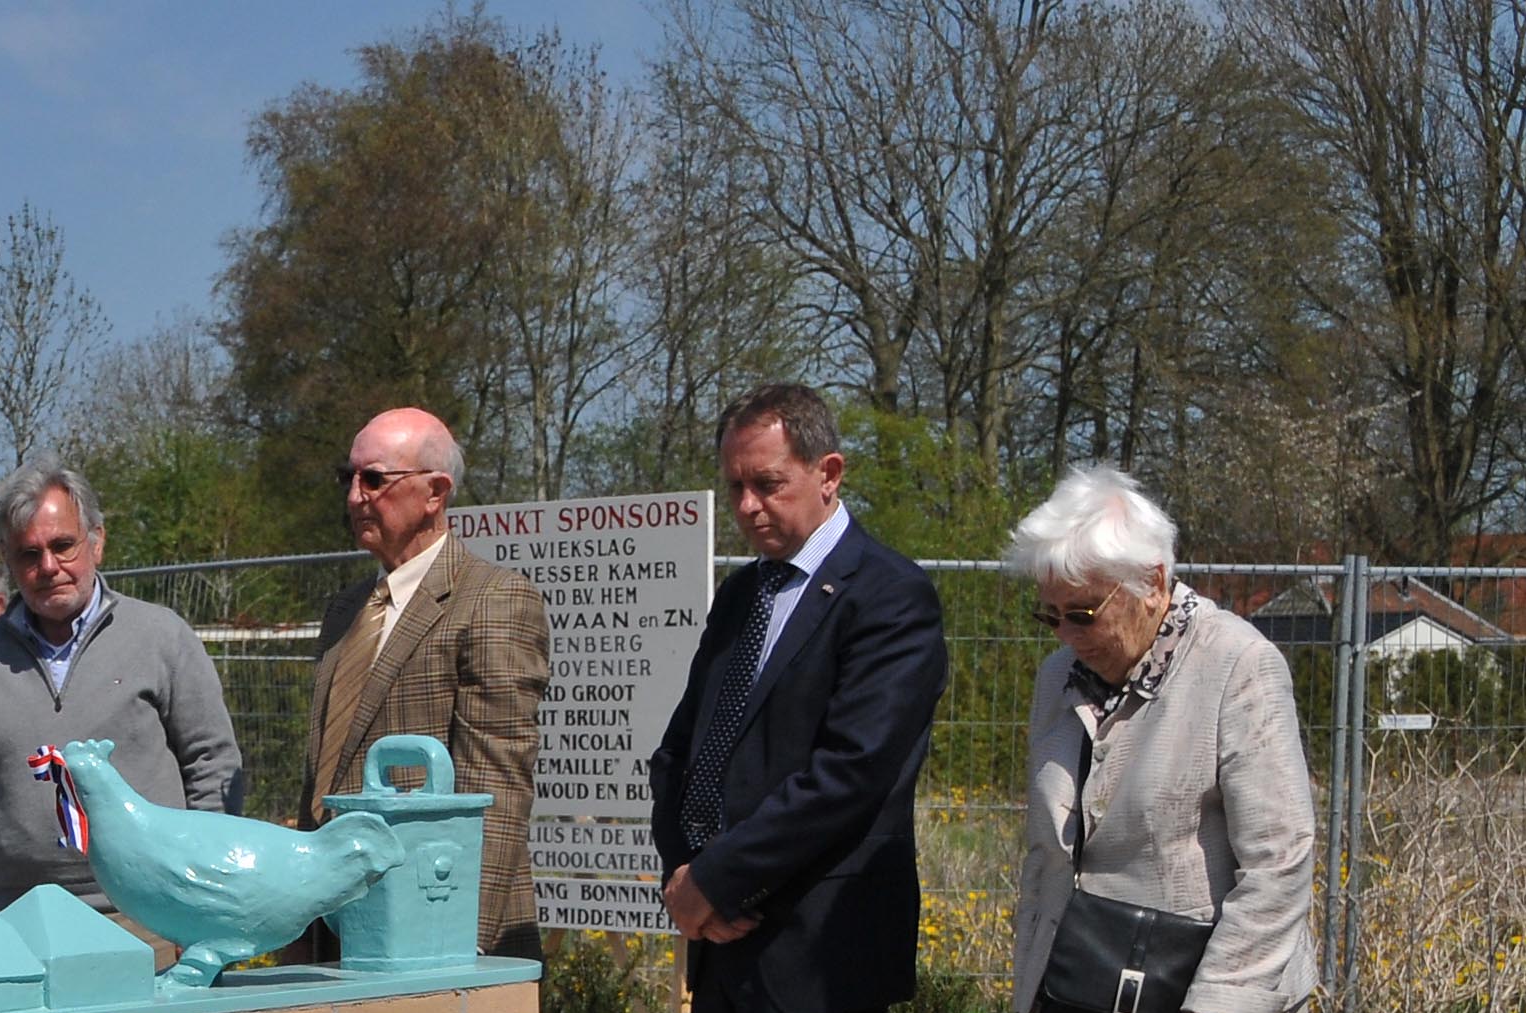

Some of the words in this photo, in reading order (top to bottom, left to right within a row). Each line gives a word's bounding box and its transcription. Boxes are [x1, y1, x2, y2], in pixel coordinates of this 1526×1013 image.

[557, 500, 699, 533] SPONSORS
[495, 543, 521, 562] DE
[529, 537, 636, 560] WIEKSLAG
[513, 564, 599, 584] NESSER
[608, 561, 678, 581] KAMER
[572, 588, 595, 606] B.V.
[601, 586, 638, 605] HEM
[550, 611, 629, 630] WAAN
[638, 613, 658, 628] en
[663, 608, 698, 628] ZN.
[554, 634, 643, 654] ENBERG
[572, 684, 636, 702] GROOT
[564, 709, 631, 726] BRUIJN
[559, 728, 633, 750] NICOLAÏ
[536, 781, 589, 799] WOUD
[596, 782, 619, 800] EN
[625, 783, 655, 801] BU
[571, 828, 594, 844] EN
[601, 828, 624, 845] DE
[531, 850, 663, 871] CHOOLCATERI
